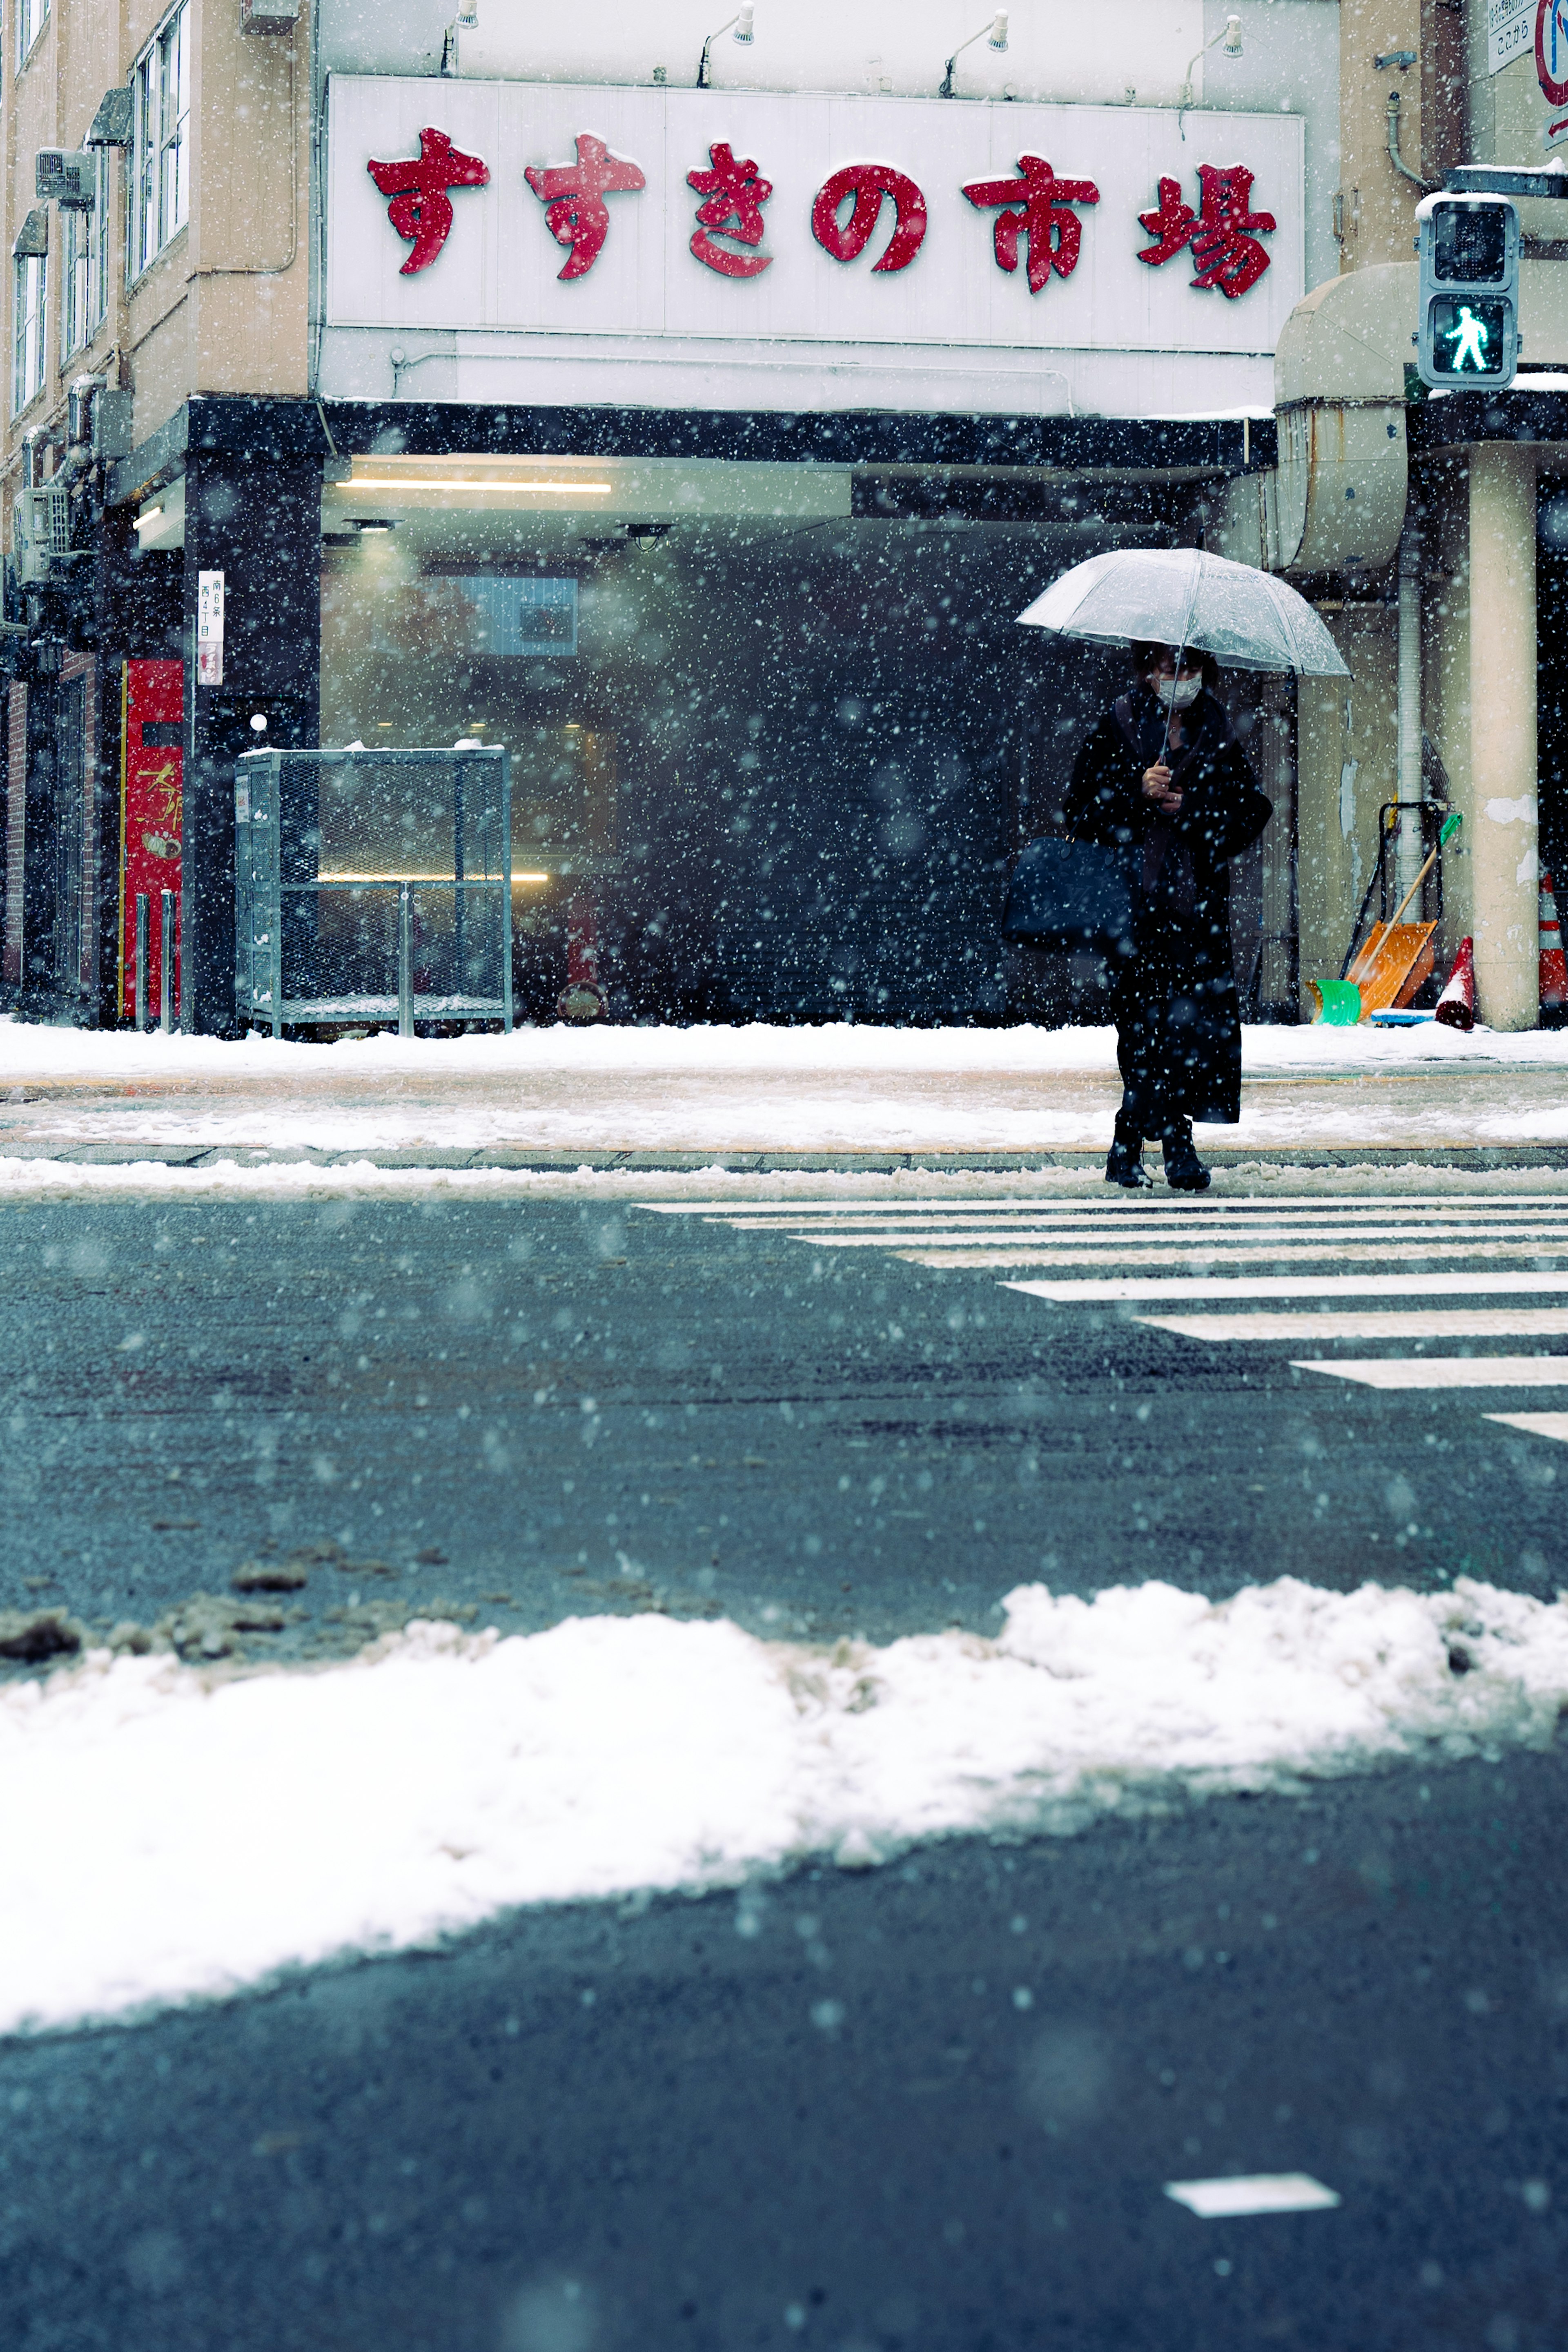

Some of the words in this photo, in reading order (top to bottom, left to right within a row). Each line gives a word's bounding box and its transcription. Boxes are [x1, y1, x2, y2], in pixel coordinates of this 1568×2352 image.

[1498, 20, 1528, 55] ここから
[367, 125, 1277, 299] すすきの市場
[201, 586, 209, 636] 西4丁目
[213, 580, 221, 617] 南6条
